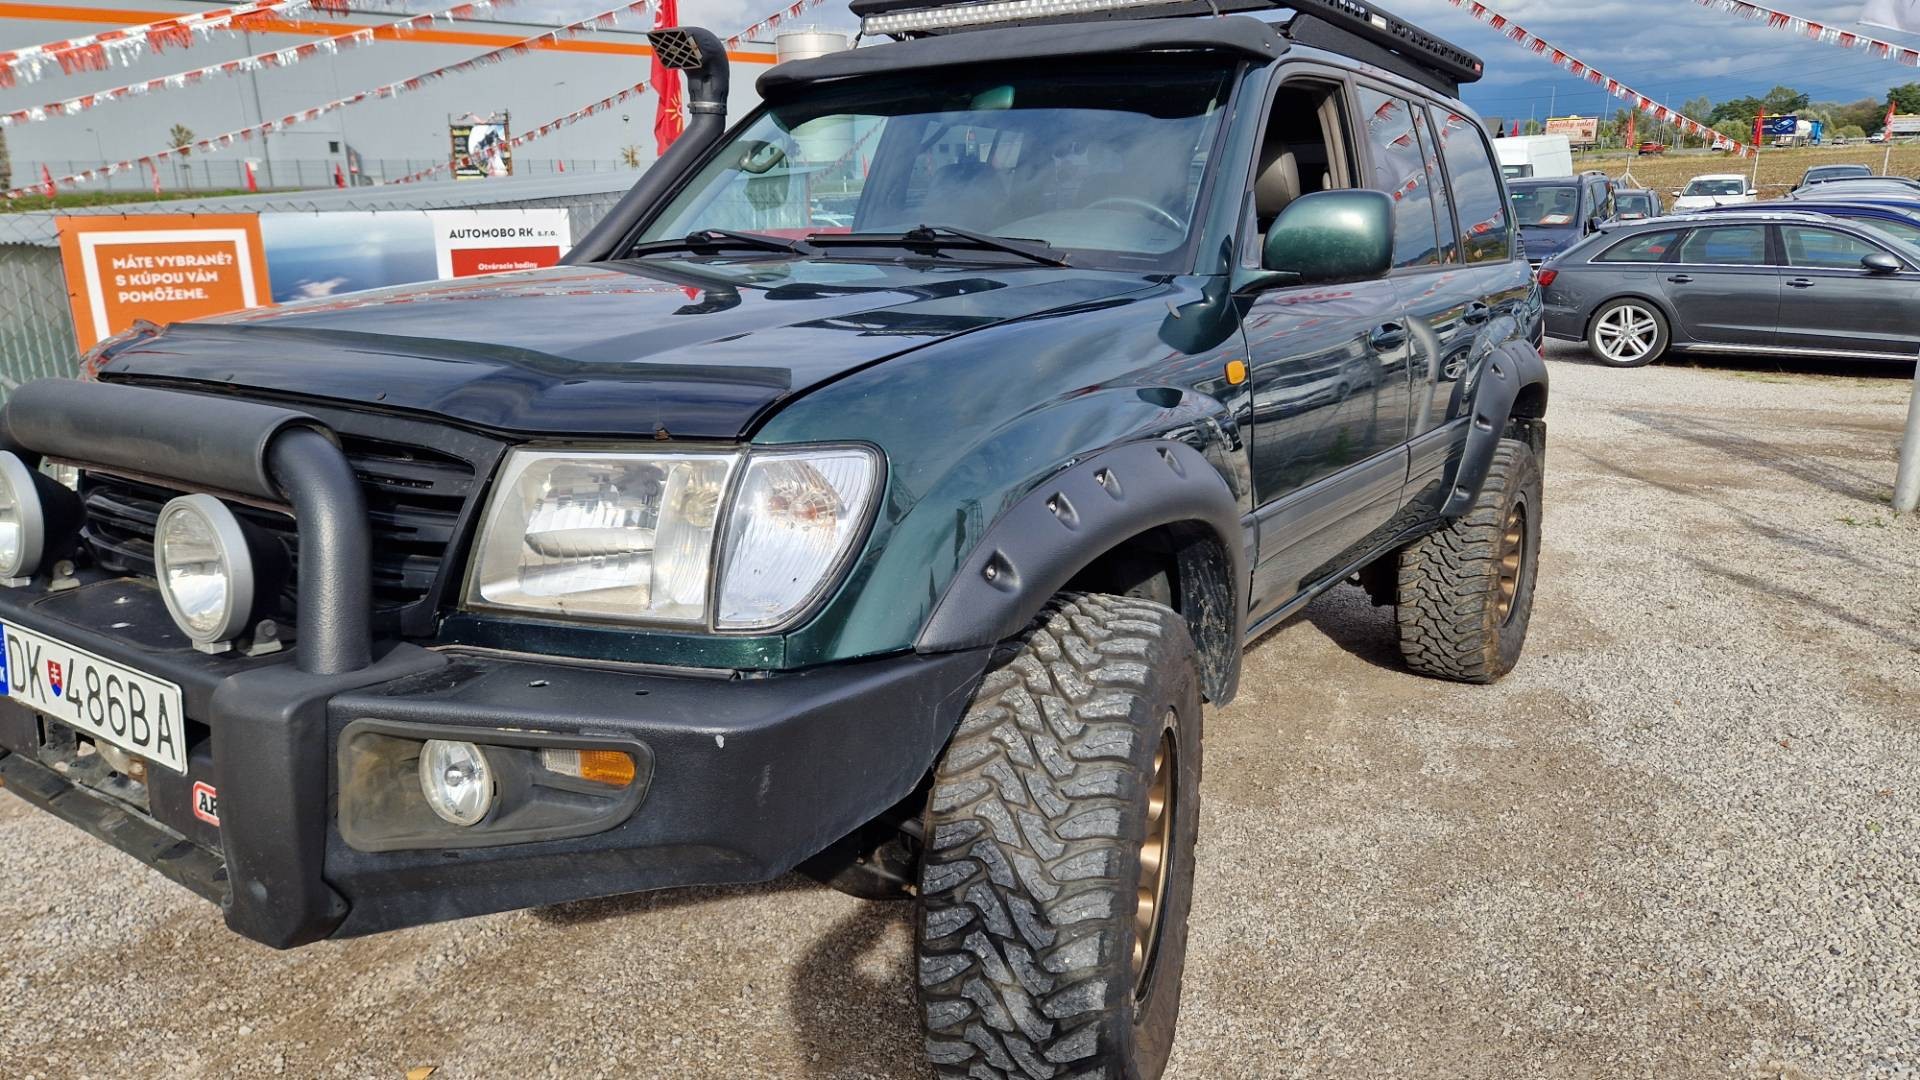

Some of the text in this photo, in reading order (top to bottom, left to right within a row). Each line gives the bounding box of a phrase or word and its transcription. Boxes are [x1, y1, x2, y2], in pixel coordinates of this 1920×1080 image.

[449, 228, 516, 239] AUTOMOBO
[518, 227, 534, 237] RK
[112, 251, 233, 269] MÁTE VYBRANÉ?
[478, 261, 538, 271] Otváracie hodiny
[115, 268, 218, 286] S KÚPOU VÁM
[118, 286, 209, 304] POMÔŽEME.
[7, 633, 176, 760] DK 486BA
